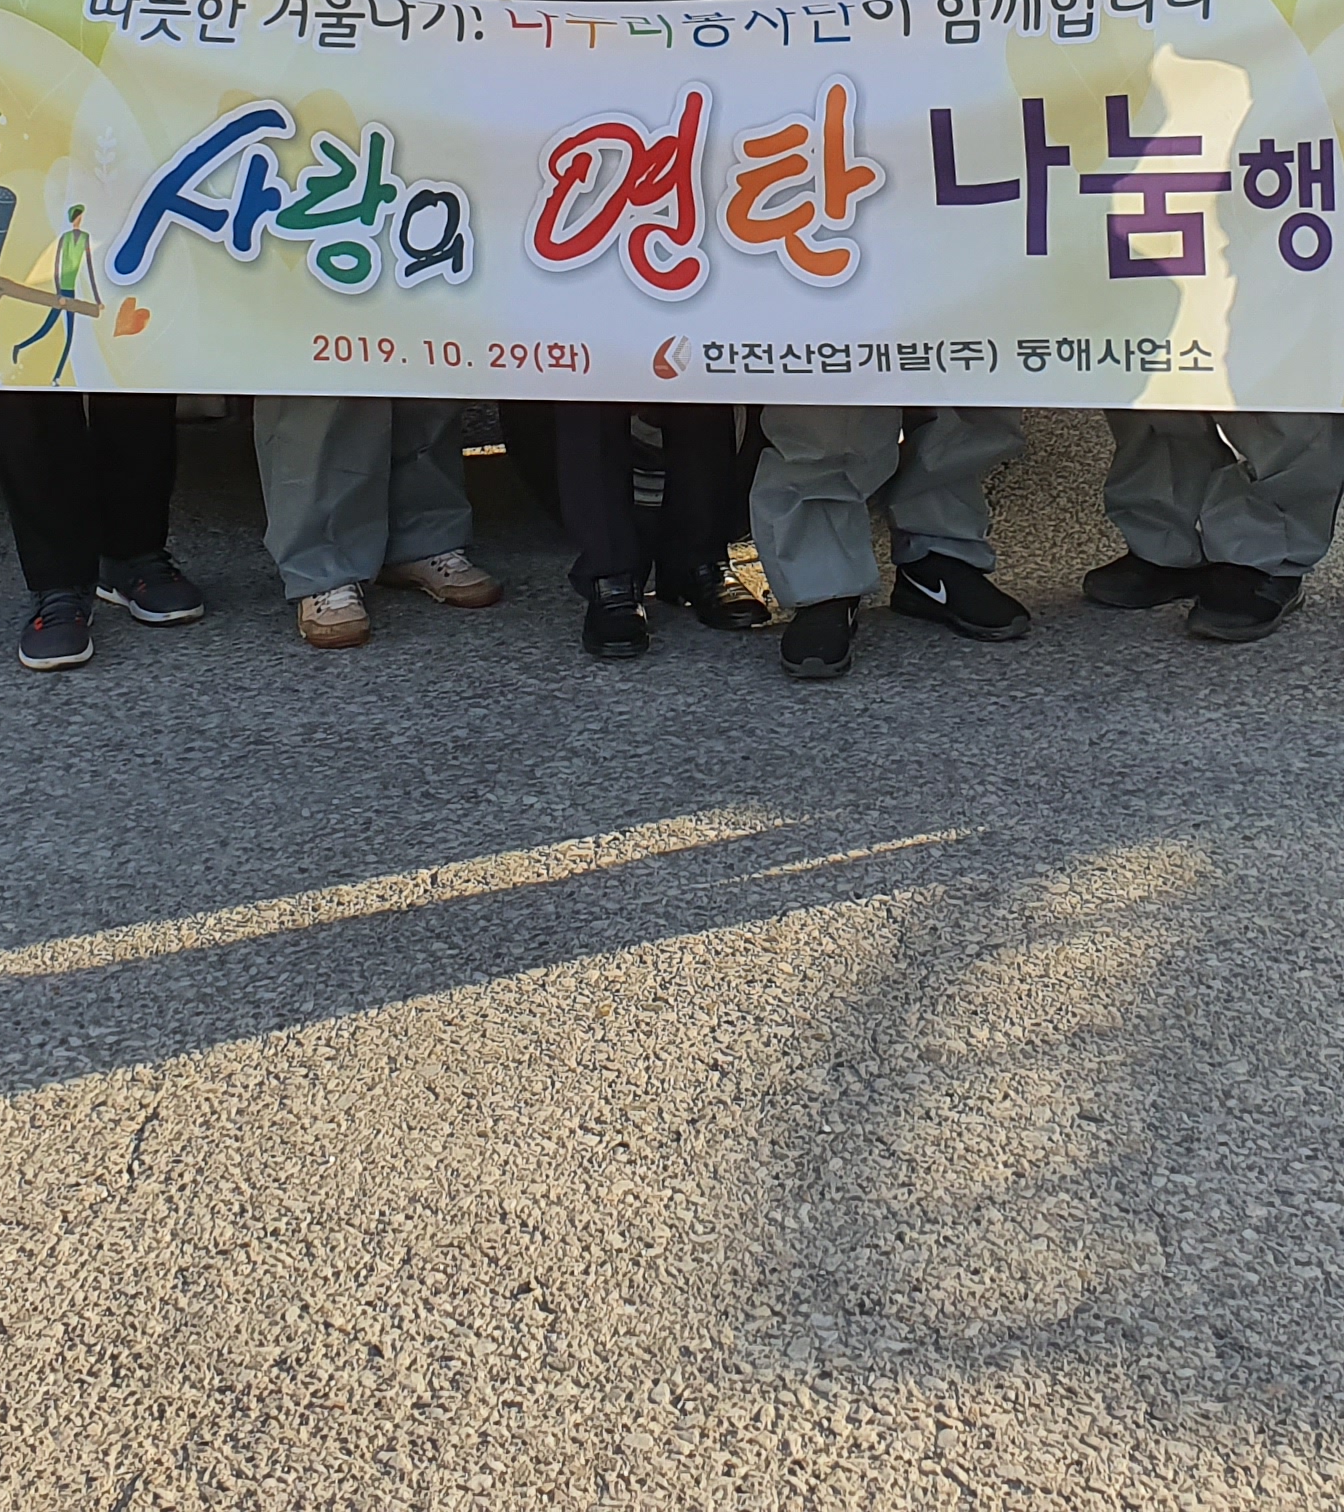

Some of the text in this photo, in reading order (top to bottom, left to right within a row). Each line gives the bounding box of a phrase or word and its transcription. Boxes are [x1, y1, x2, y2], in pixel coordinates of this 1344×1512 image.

[115, 108, 464, 285] 사랑의
[533, 83, 876, 291] 연탄
[312, 334, 592, 375] 2019. 10. 29(화)
[702, 336, 1216, 376] 한전산업개발(주) 동해사업소
